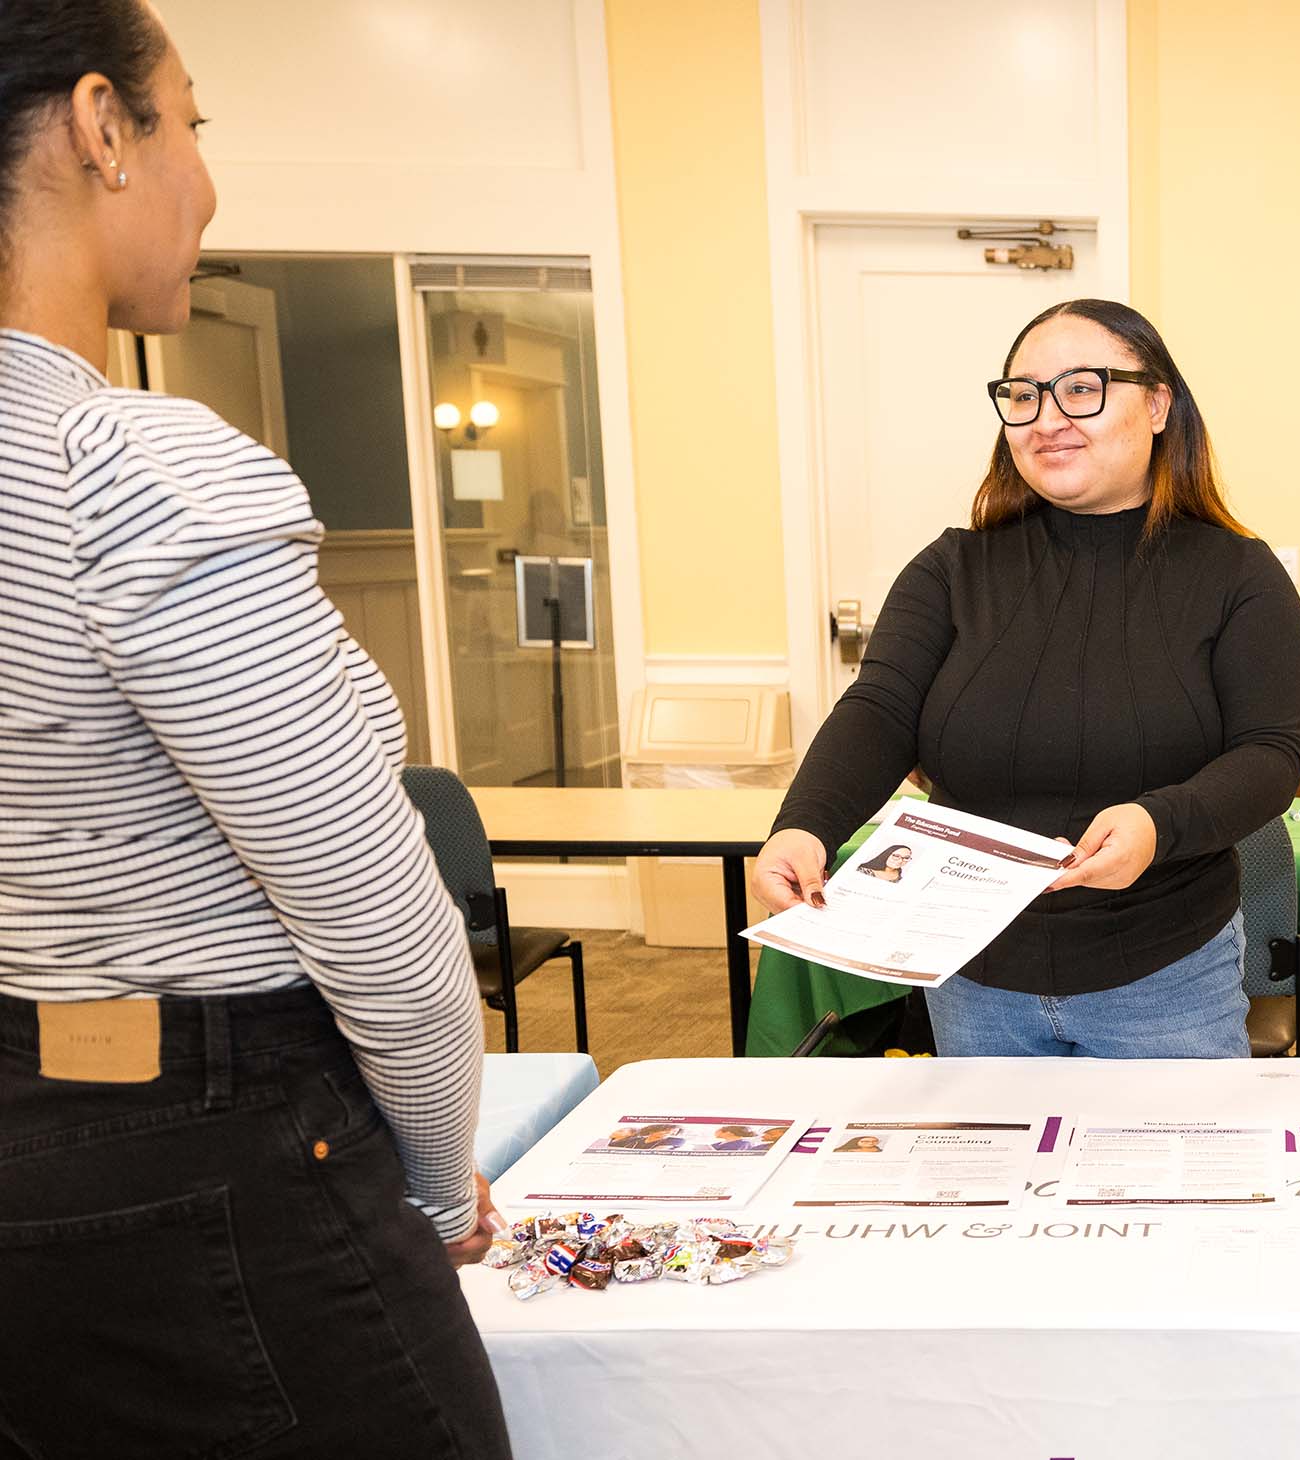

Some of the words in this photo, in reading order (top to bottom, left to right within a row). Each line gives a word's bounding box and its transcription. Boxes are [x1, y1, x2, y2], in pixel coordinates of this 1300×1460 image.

[904, 816, 916, 824] The
[948, 855, 990, 874] Career
[940, 865, 1009, 886] Counseling
[962, 1223, 1013, 1239] &
[1018, 1223, 1163, 1239] JOINT
